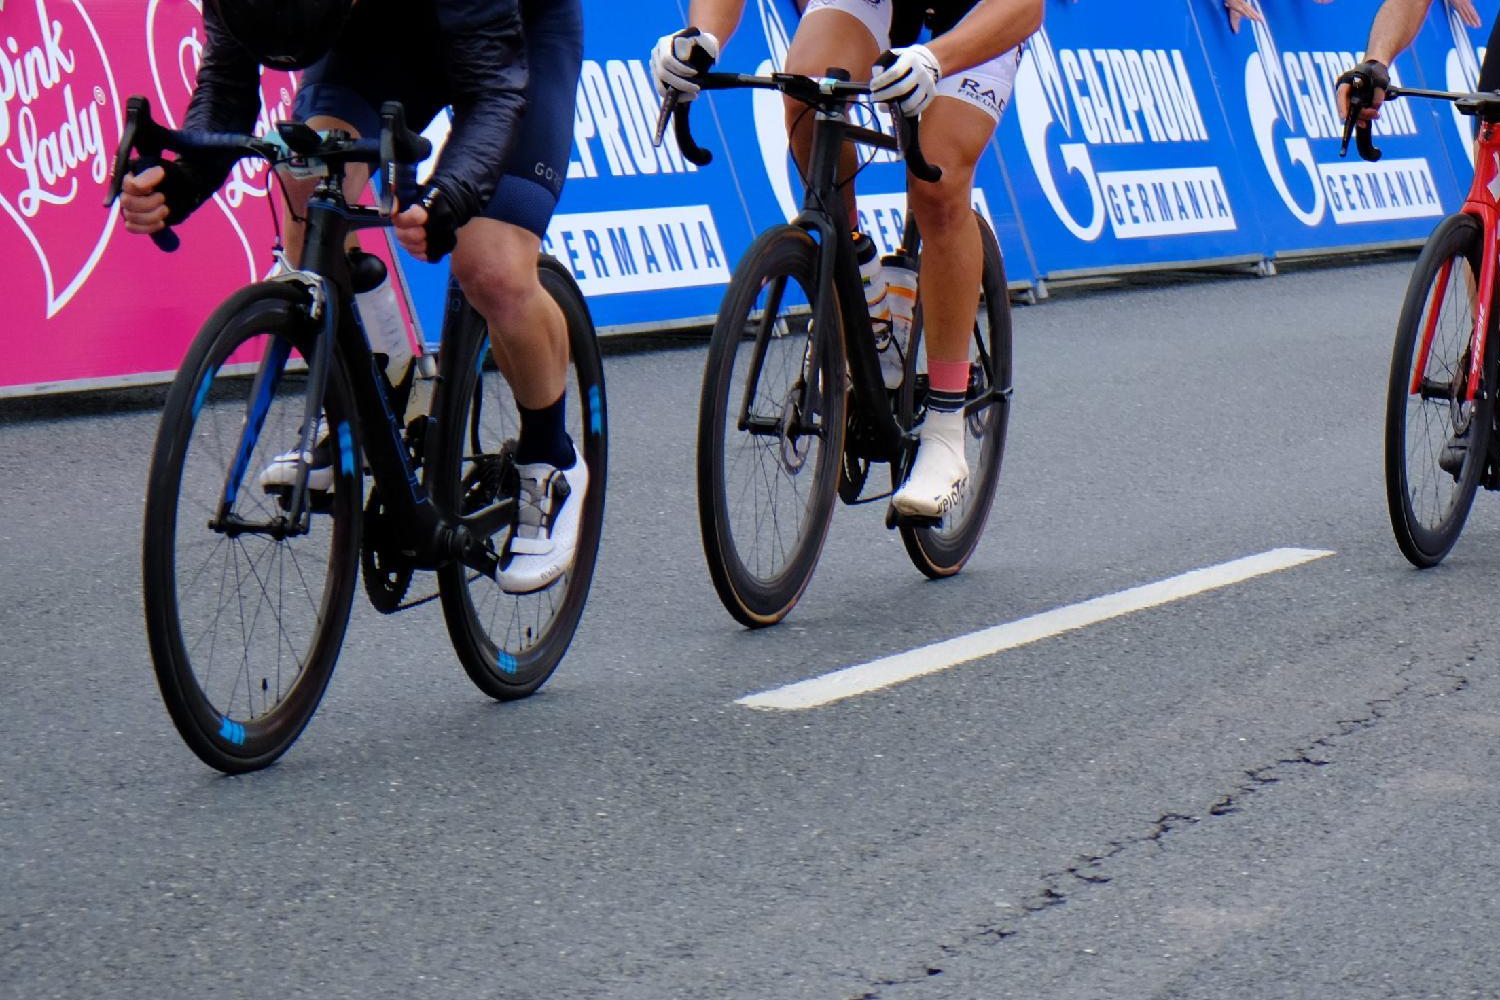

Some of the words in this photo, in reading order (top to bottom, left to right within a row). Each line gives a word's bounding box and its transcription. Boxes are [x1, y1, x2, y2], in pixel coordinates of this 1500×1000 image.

[1060, 49, 1208, 144] GAZPROM
[7, 83, 107, 218] Lady
[1107, 180, 1230, 225] GERMANIA
[1327, 169, 1435, 212] GERMANIA
